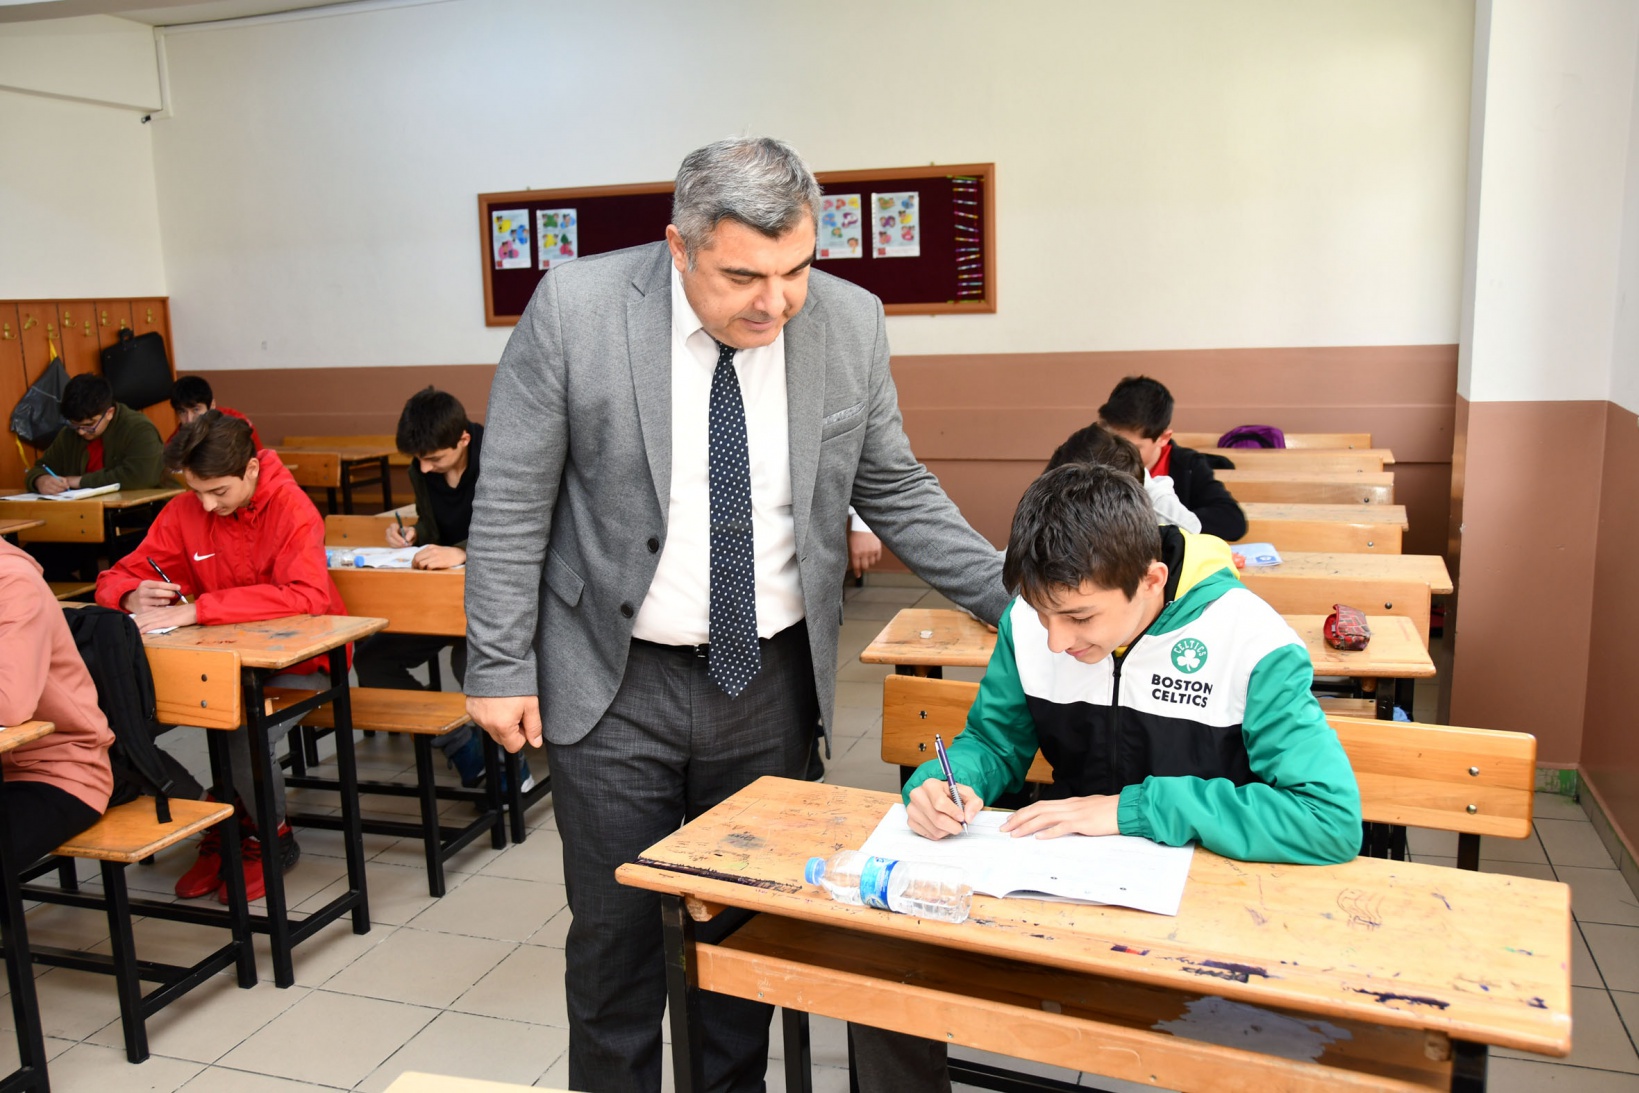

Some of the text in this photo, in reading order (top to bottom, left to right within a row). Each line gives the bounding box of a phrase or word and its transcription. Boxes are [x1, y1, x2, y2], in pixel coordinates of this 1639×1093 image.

[1174, 640, 1206, 656] CELTICS
[1152, 674, 1213, 695] BOSTON
[1152, 688, 1208, 708] CELTICS
